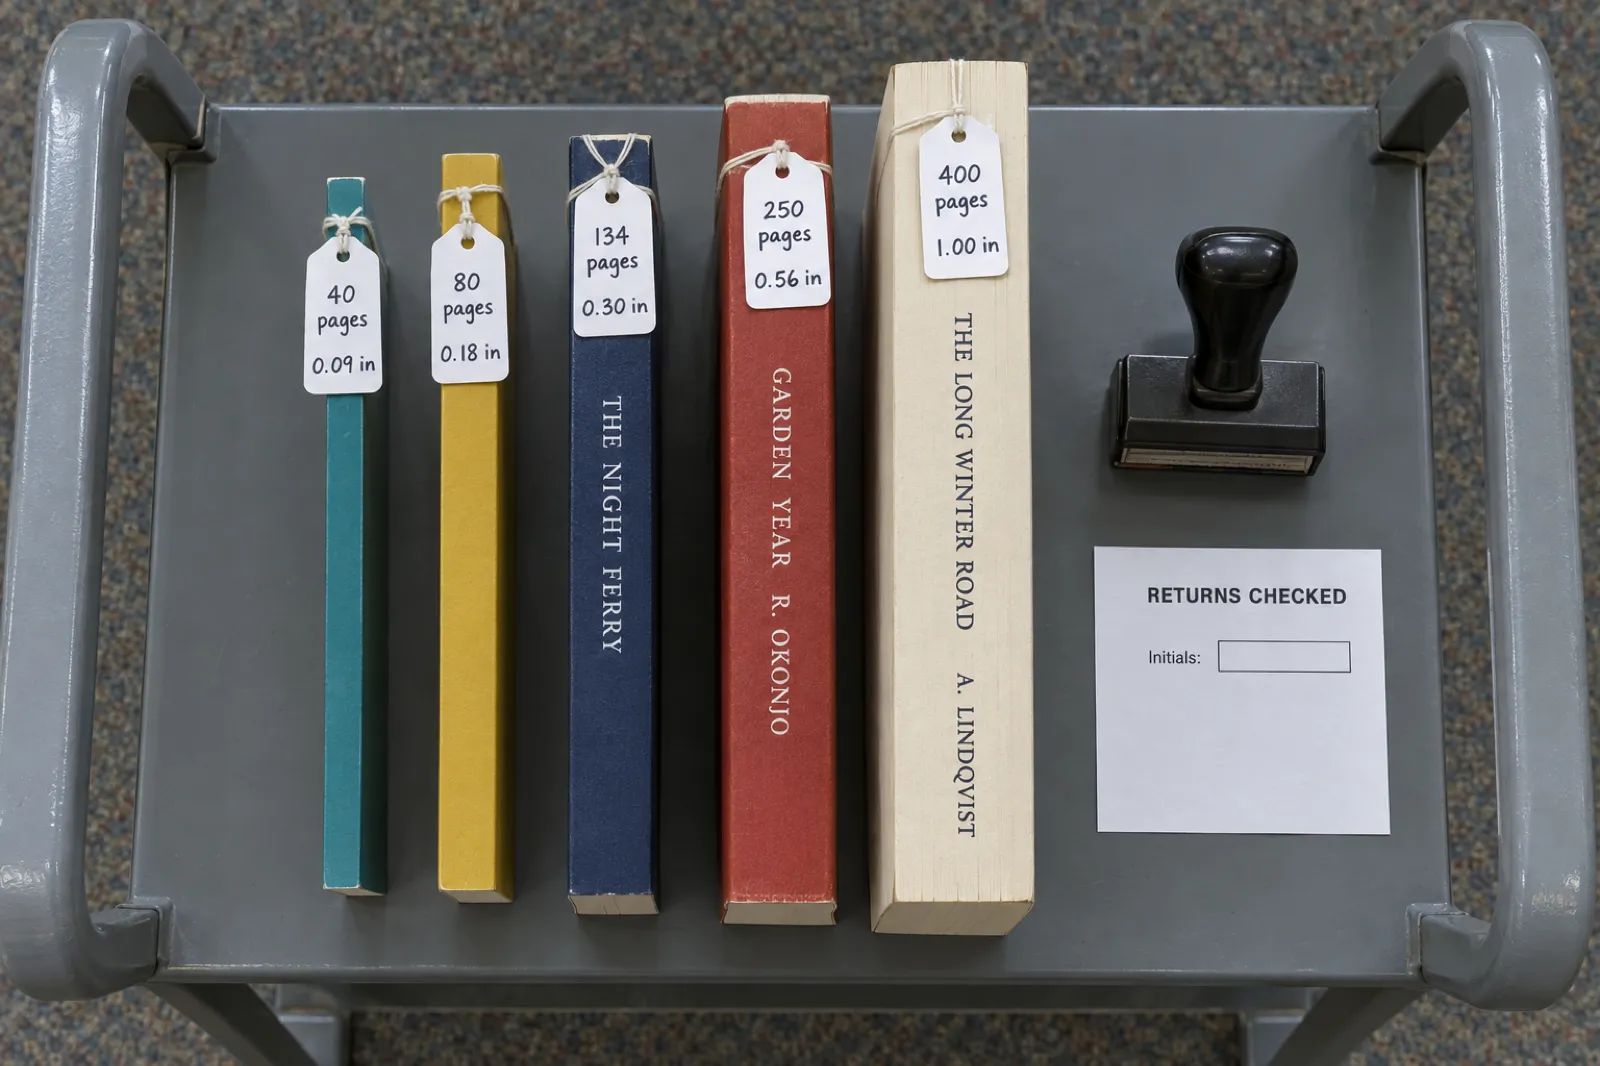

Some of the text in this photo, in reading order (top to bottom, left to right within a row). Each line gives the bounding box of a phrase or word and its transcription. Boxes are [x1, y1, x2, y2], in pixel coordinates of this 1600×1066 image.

[937, 163, 981, 186] 400
[763, 199, 805, 221] 250
[934, 193, 989, 218] pages
[595, 225, 630, 247] 134
[758, 228, 812, 252] pages
[937, 235, 1000, 257] 1.00 in
[586, 255, 639, 279] pages
[453, 272, 481, 293] 80
[754, 269, 823, 290] 0.56 in
[326, 284, 356, 305] 40
[443, 302, 494, 325] pages
[581, 297, 649, 317] 0.30 in
[317, 313, 368, 337] pages
[440, 342, 501, 363] 0.18 in
[311, 354, 376, 375] 0.09 in
[602, 395, 623, 654] THE NIGHT FERRY
[768, 367, 792, 736] GARDEN YEAR R. OKONJO
[952, 312, 976, 838] THE LONG WINTER ROAD A. LINDQVIST
[1147, 586, 1347, 605] RETURNS CHECKED
[1149, 649, 1201, 665] Initials:
